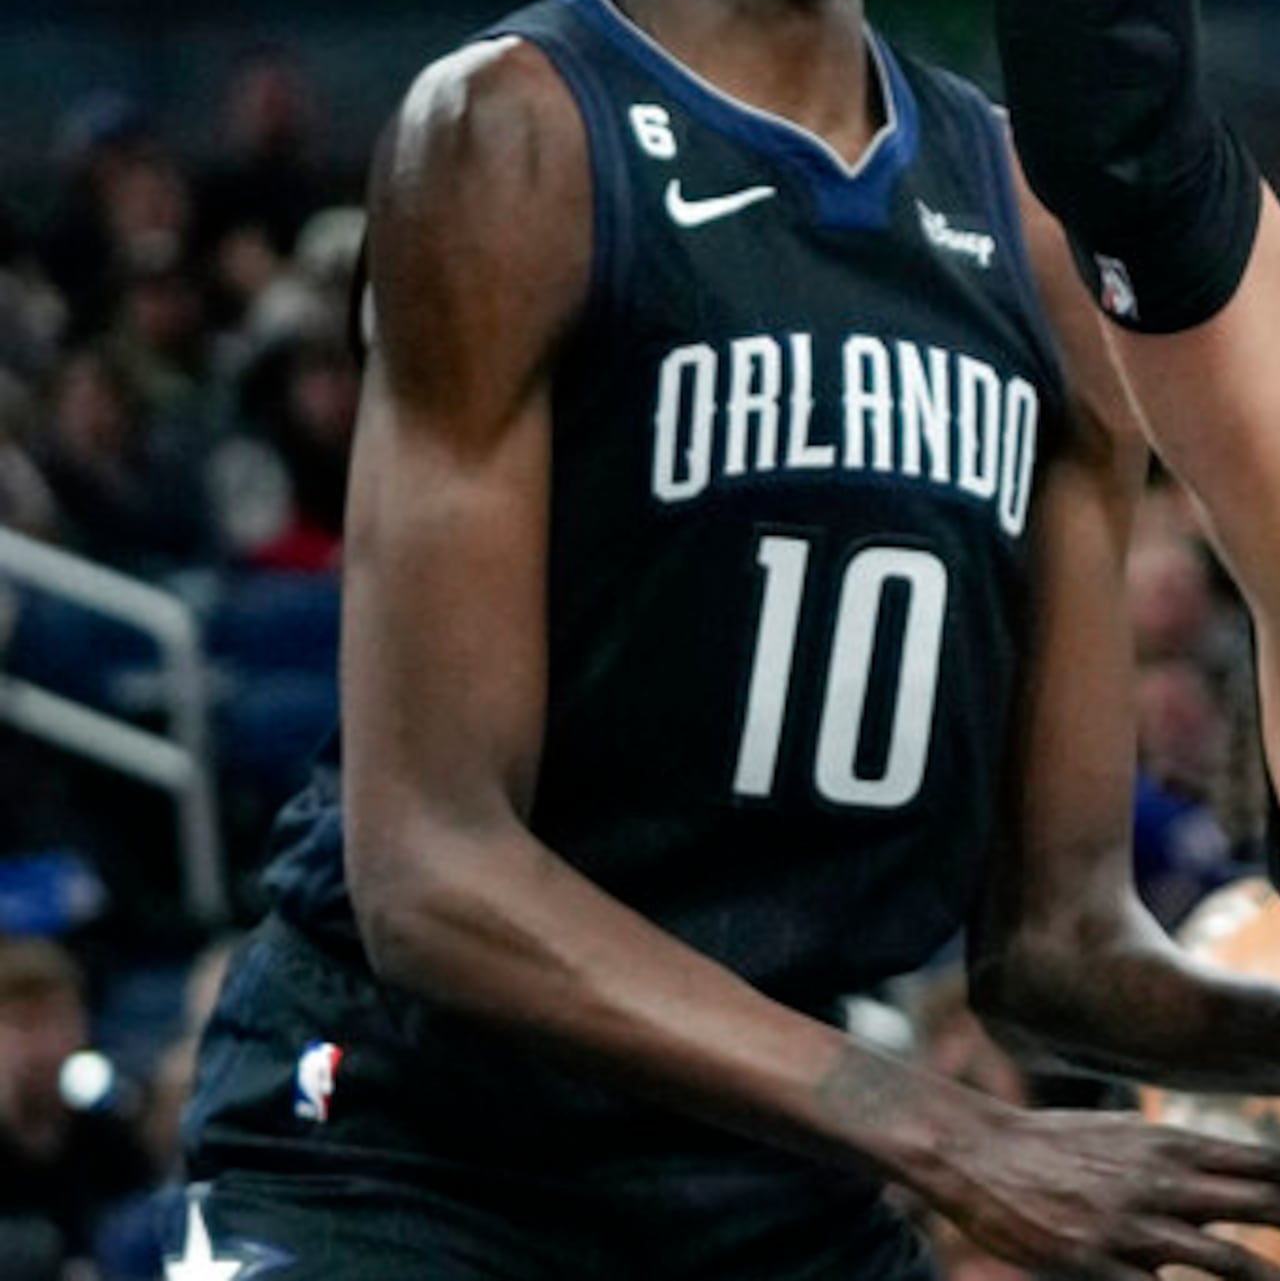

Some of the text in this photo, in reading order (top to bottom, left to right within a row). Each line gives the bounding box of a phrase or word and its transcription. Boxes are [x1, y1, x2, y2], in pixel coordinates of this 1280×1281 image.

[628, 103, 677, 160] 6
[651, 332, 1039, 538] ORLANDO
[733, 535, 948, 809] 10
